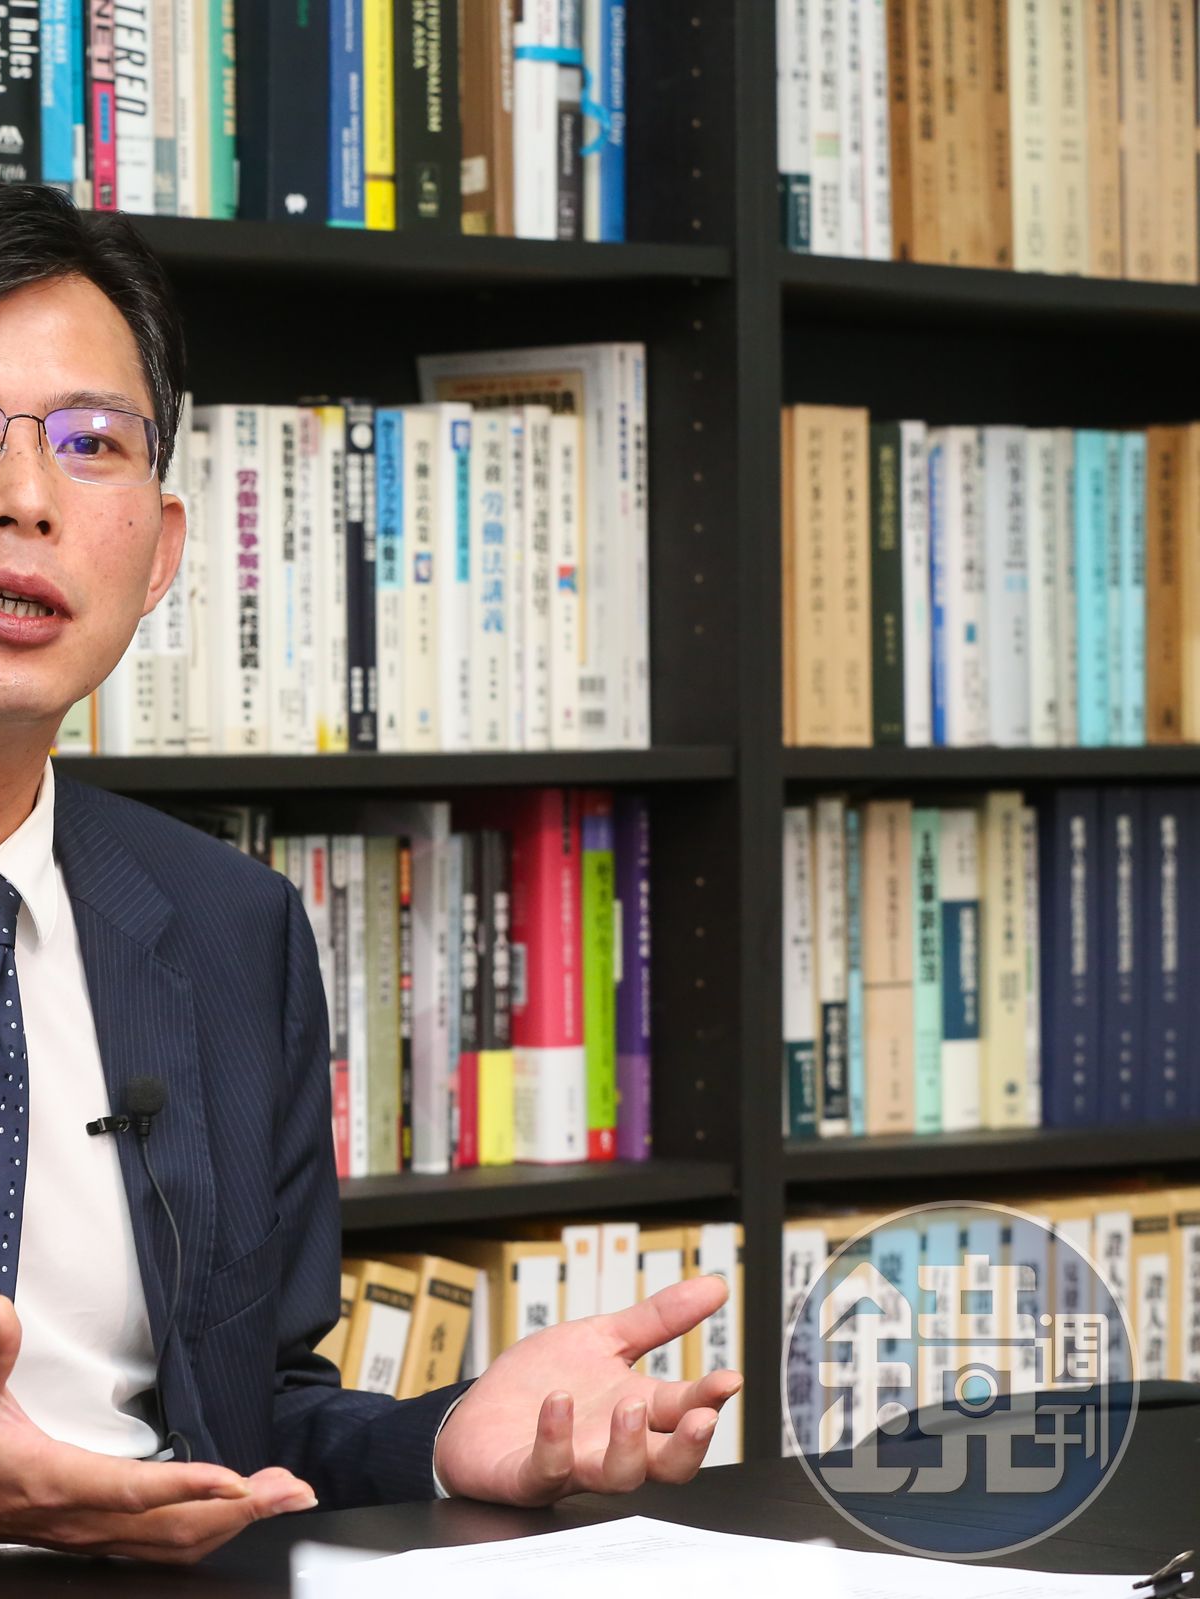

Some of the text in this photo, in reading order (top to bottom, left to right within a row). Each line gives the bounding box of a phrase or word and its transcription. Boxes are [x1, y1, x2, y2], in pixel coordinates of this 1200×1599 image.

[8, 18, 39, 79] Rules
[55, 23, 67, 64] RULES
[413, 24, 426, 68] ASIA
[608, 6, 625, 145] Deliberation Day
